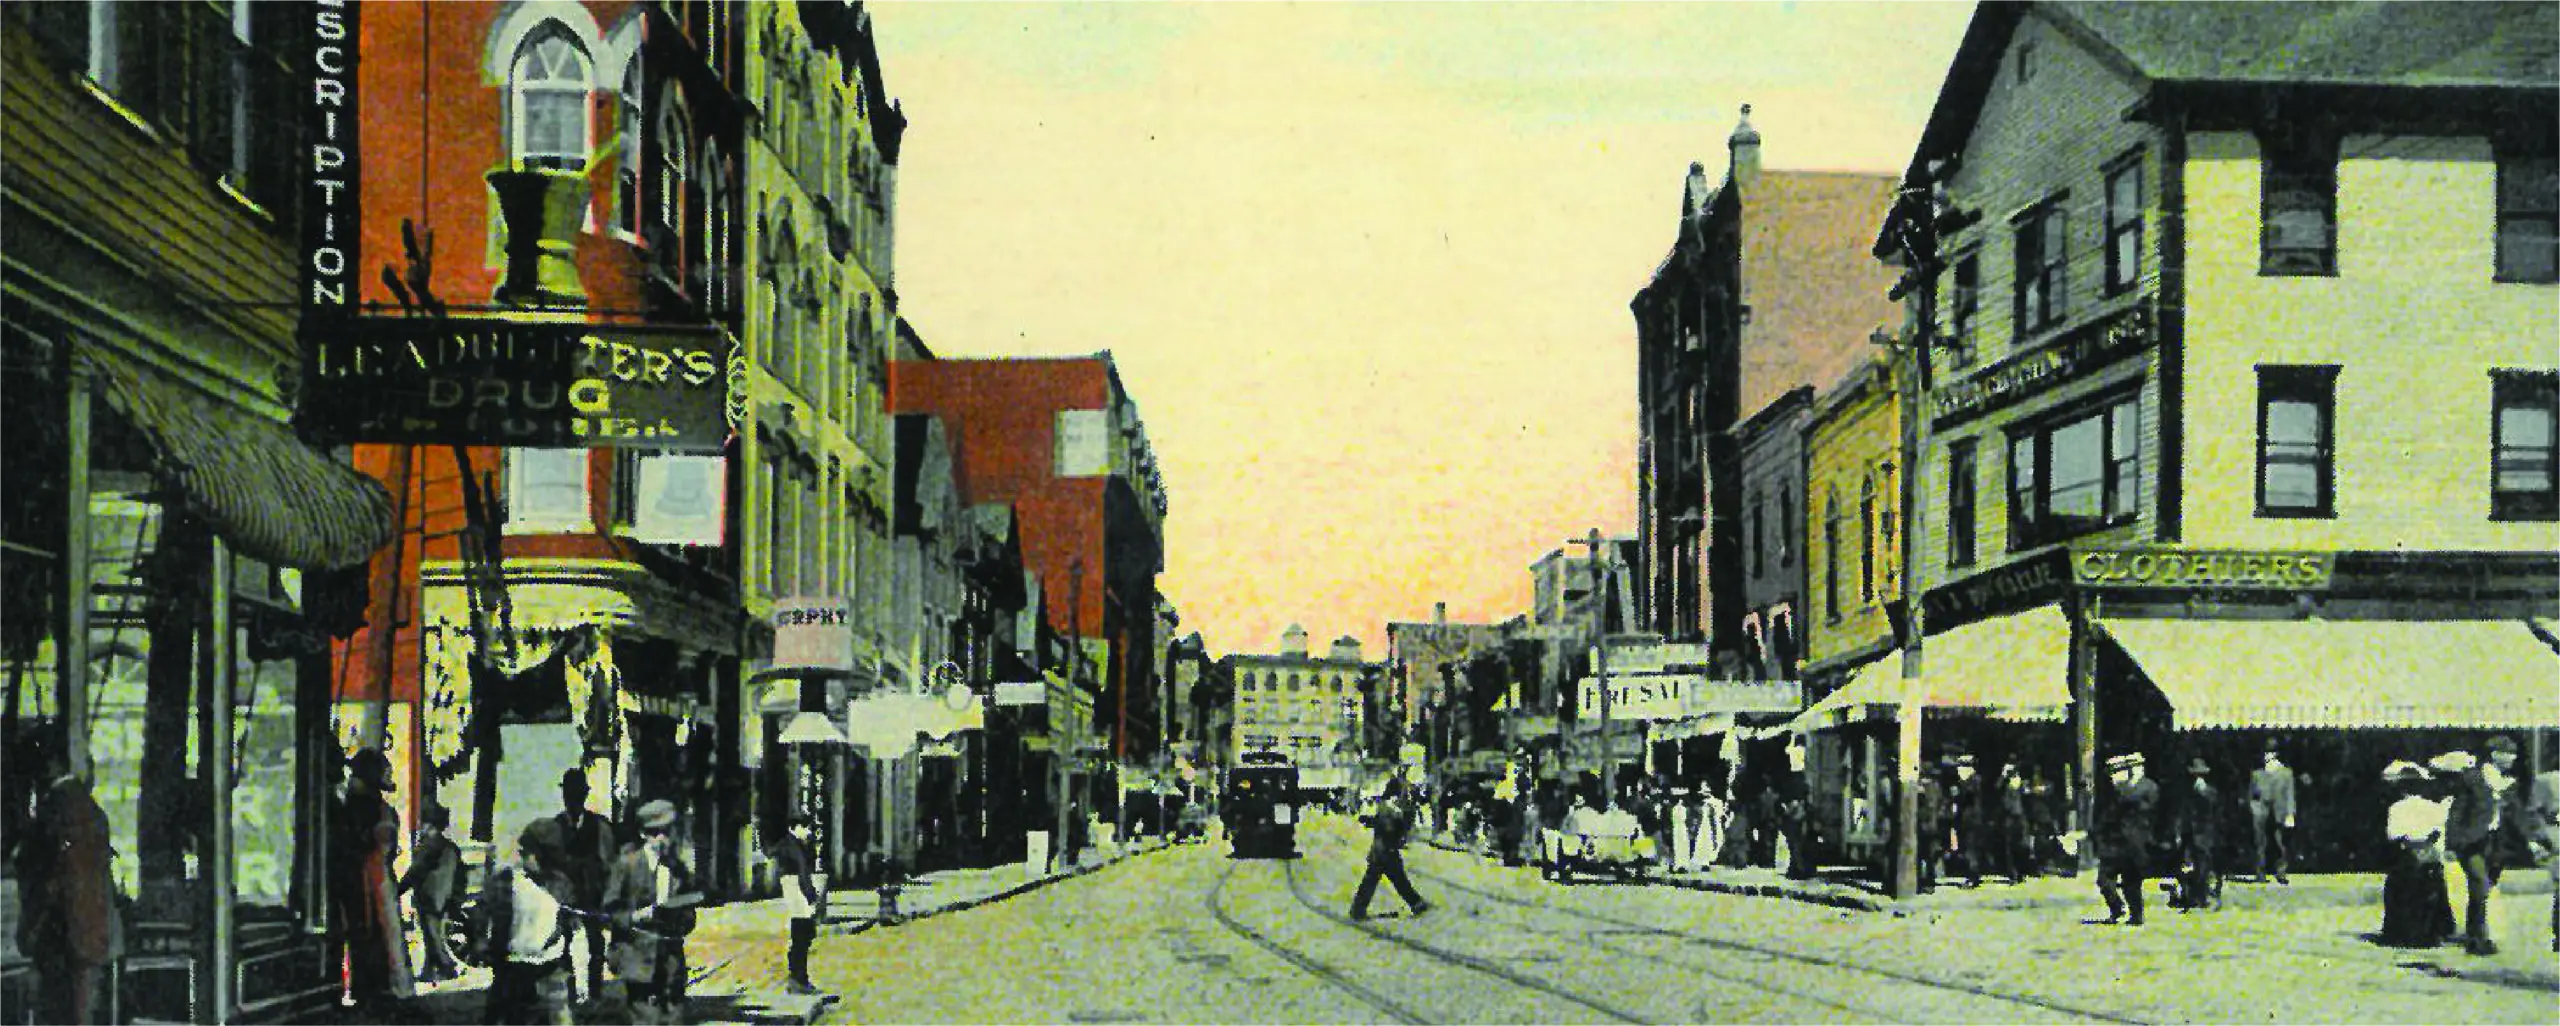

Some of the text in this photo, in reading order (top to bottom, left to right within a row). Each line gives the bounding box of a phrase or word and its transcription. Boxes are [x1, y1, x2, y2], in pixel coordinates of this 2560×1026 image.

[312, 0, 346, 305] SCRIPTION
[428, 377, 611, 413] DRUG
[2079, 551, 2327, 581] CLOTHIERS
